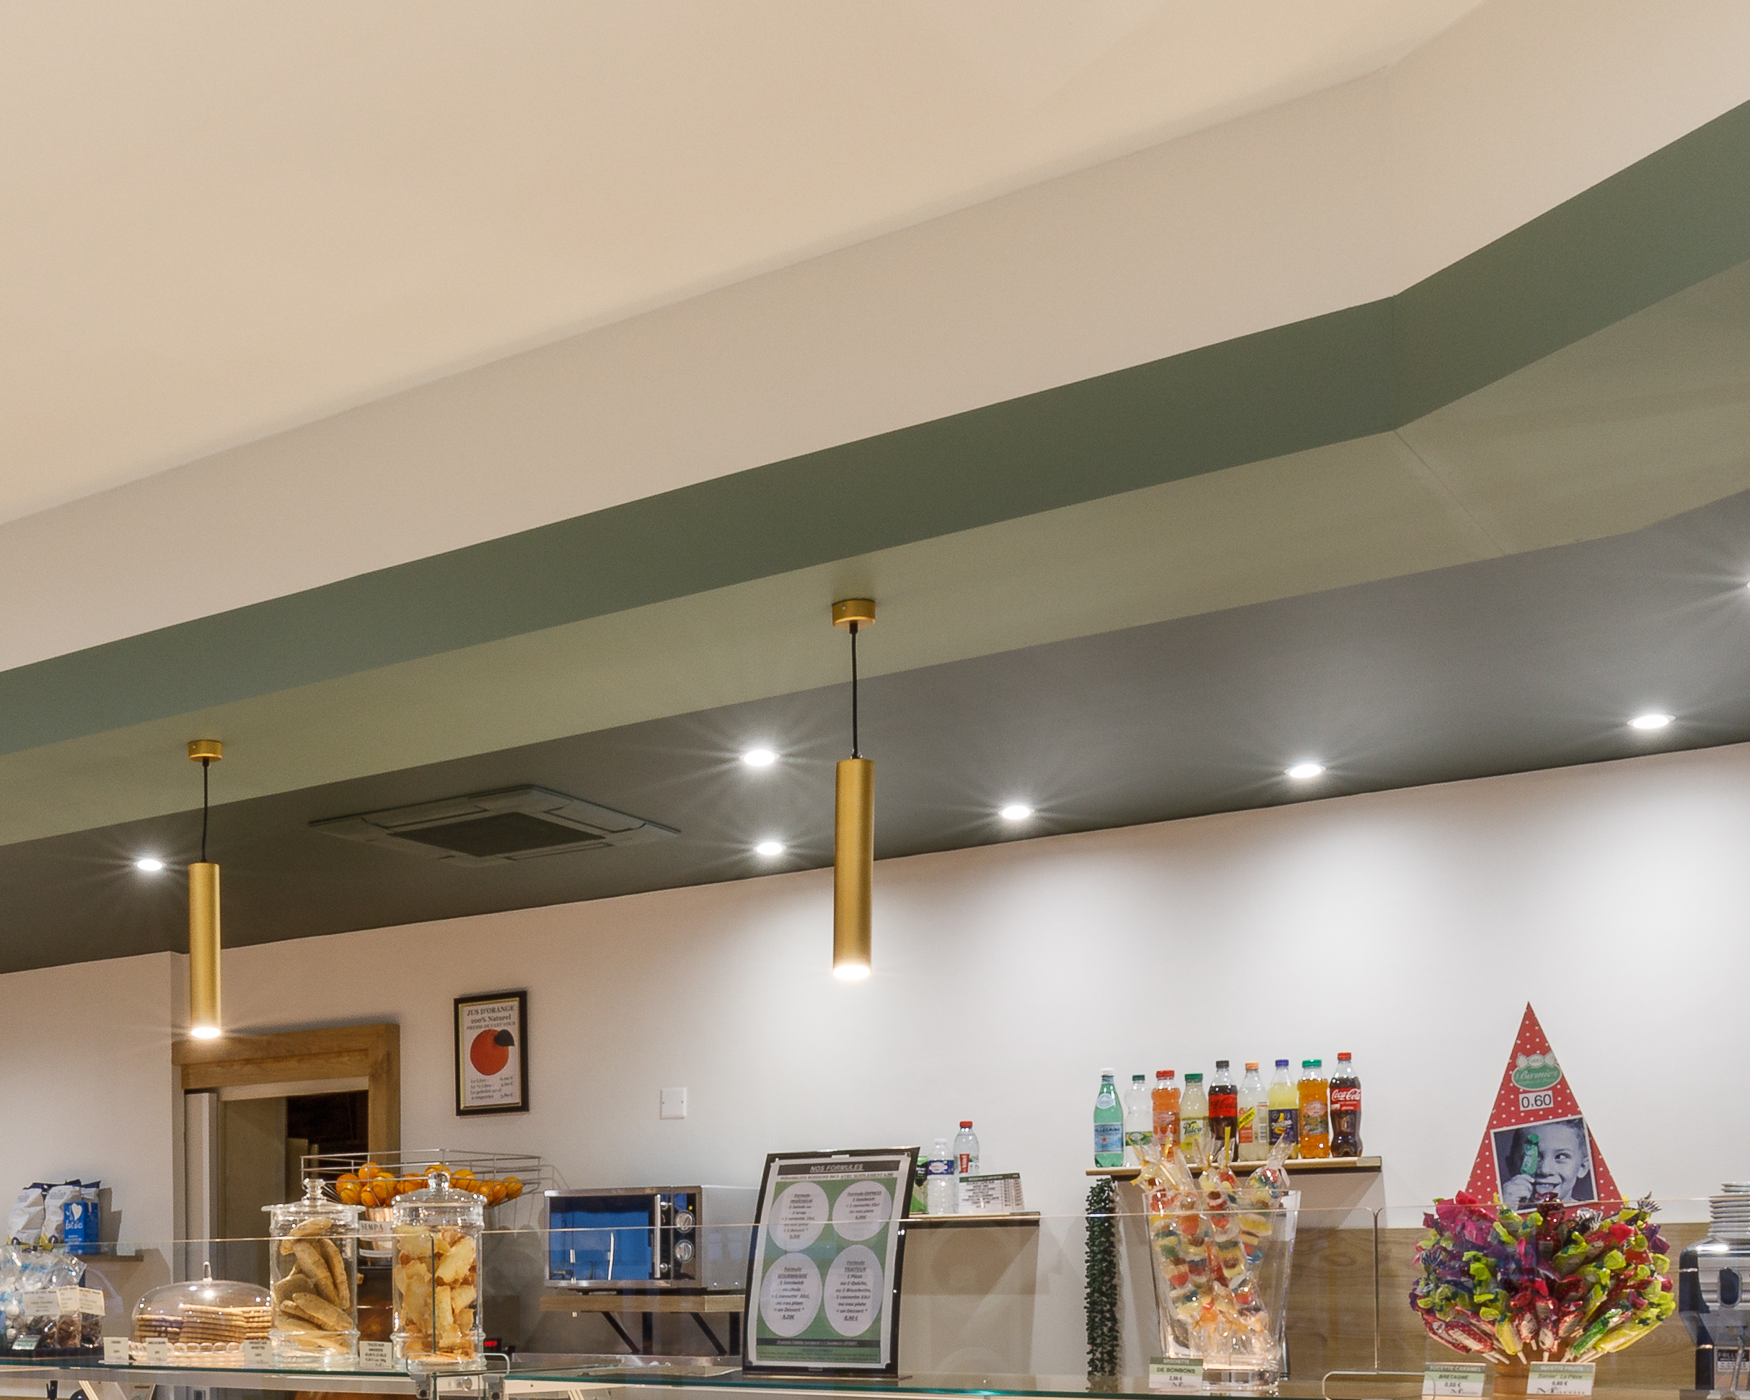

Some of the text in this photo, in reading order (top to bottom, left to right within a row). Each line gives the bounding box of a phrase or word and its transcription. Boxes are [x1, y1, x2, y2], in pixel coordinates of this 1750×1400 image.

[467, 1006, 514, 1017] JUS D'ORANGE
[488, 1013, 511, 1022] Naturel
[1183, 1121, 1202, 1135] Pulco
[826, 1163, 864, 1171] FORMULES
